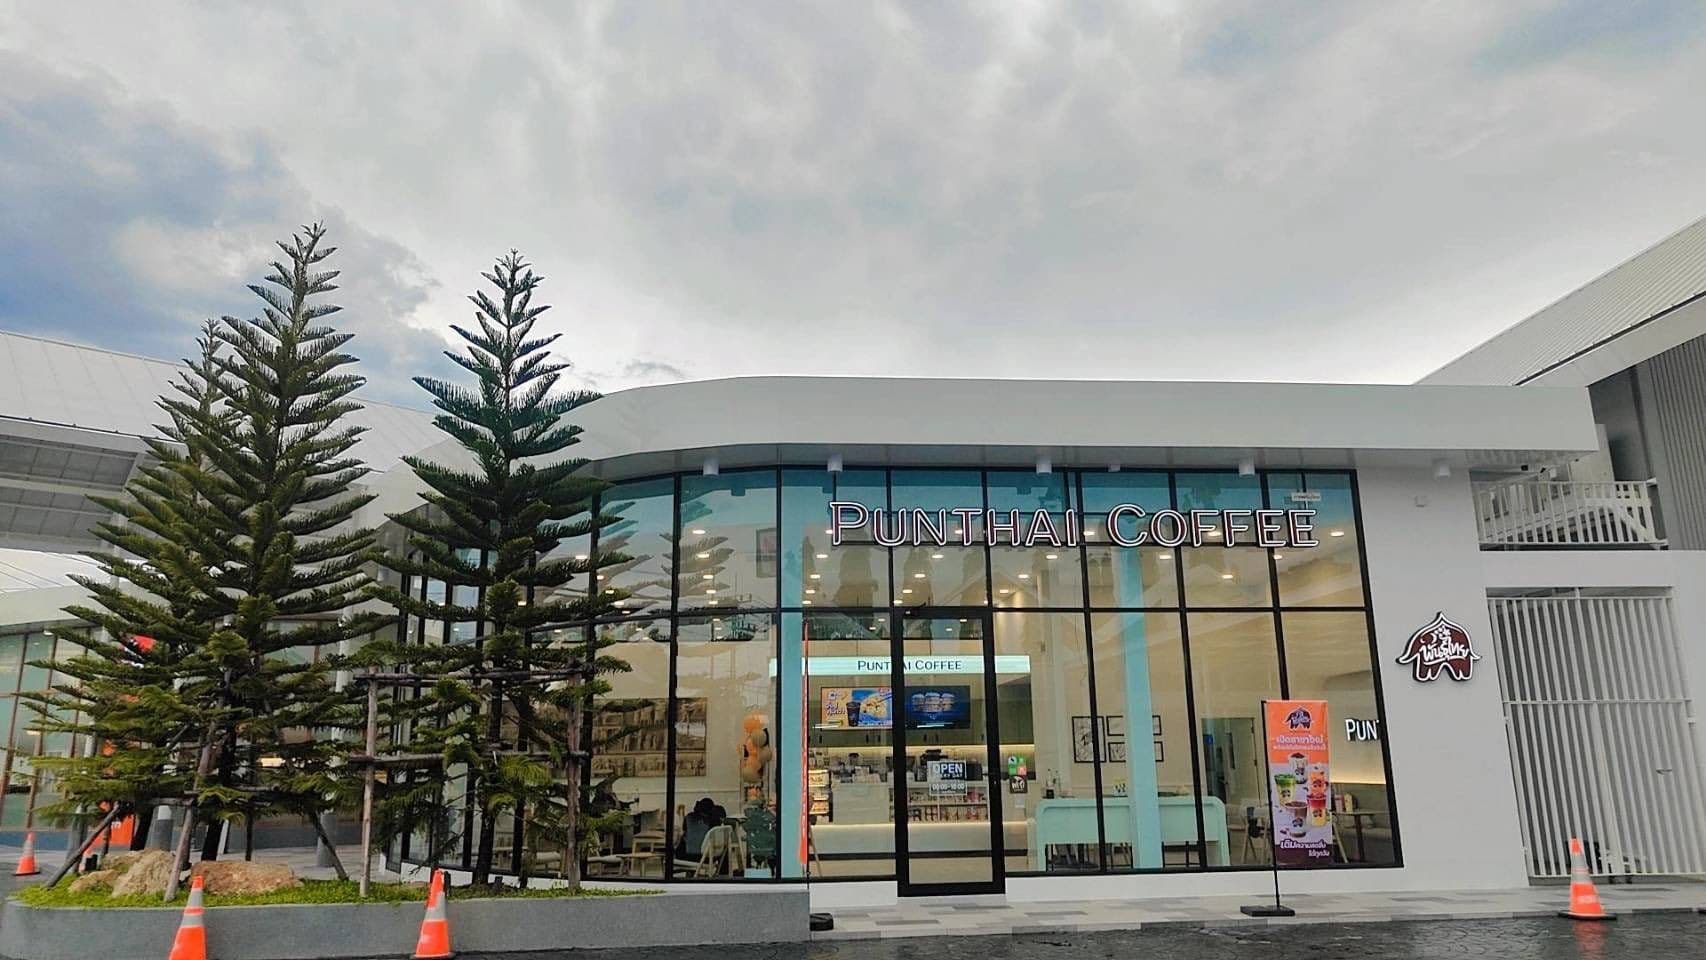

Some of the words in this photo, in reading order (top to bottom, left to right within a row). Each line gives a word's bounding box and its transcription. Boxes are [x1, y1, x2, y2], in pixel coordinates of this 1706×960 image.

[829, 502, 1077, 547] PUNTHAI
[1106, 503, 1320, 547] COFFEE
[857, 660, 911, 671] PUNTI
[915, 660, 962, 670] COFFEE
[1345, 718, 1379, 741] PUN
[933, 763, 963, 773] OPEN
